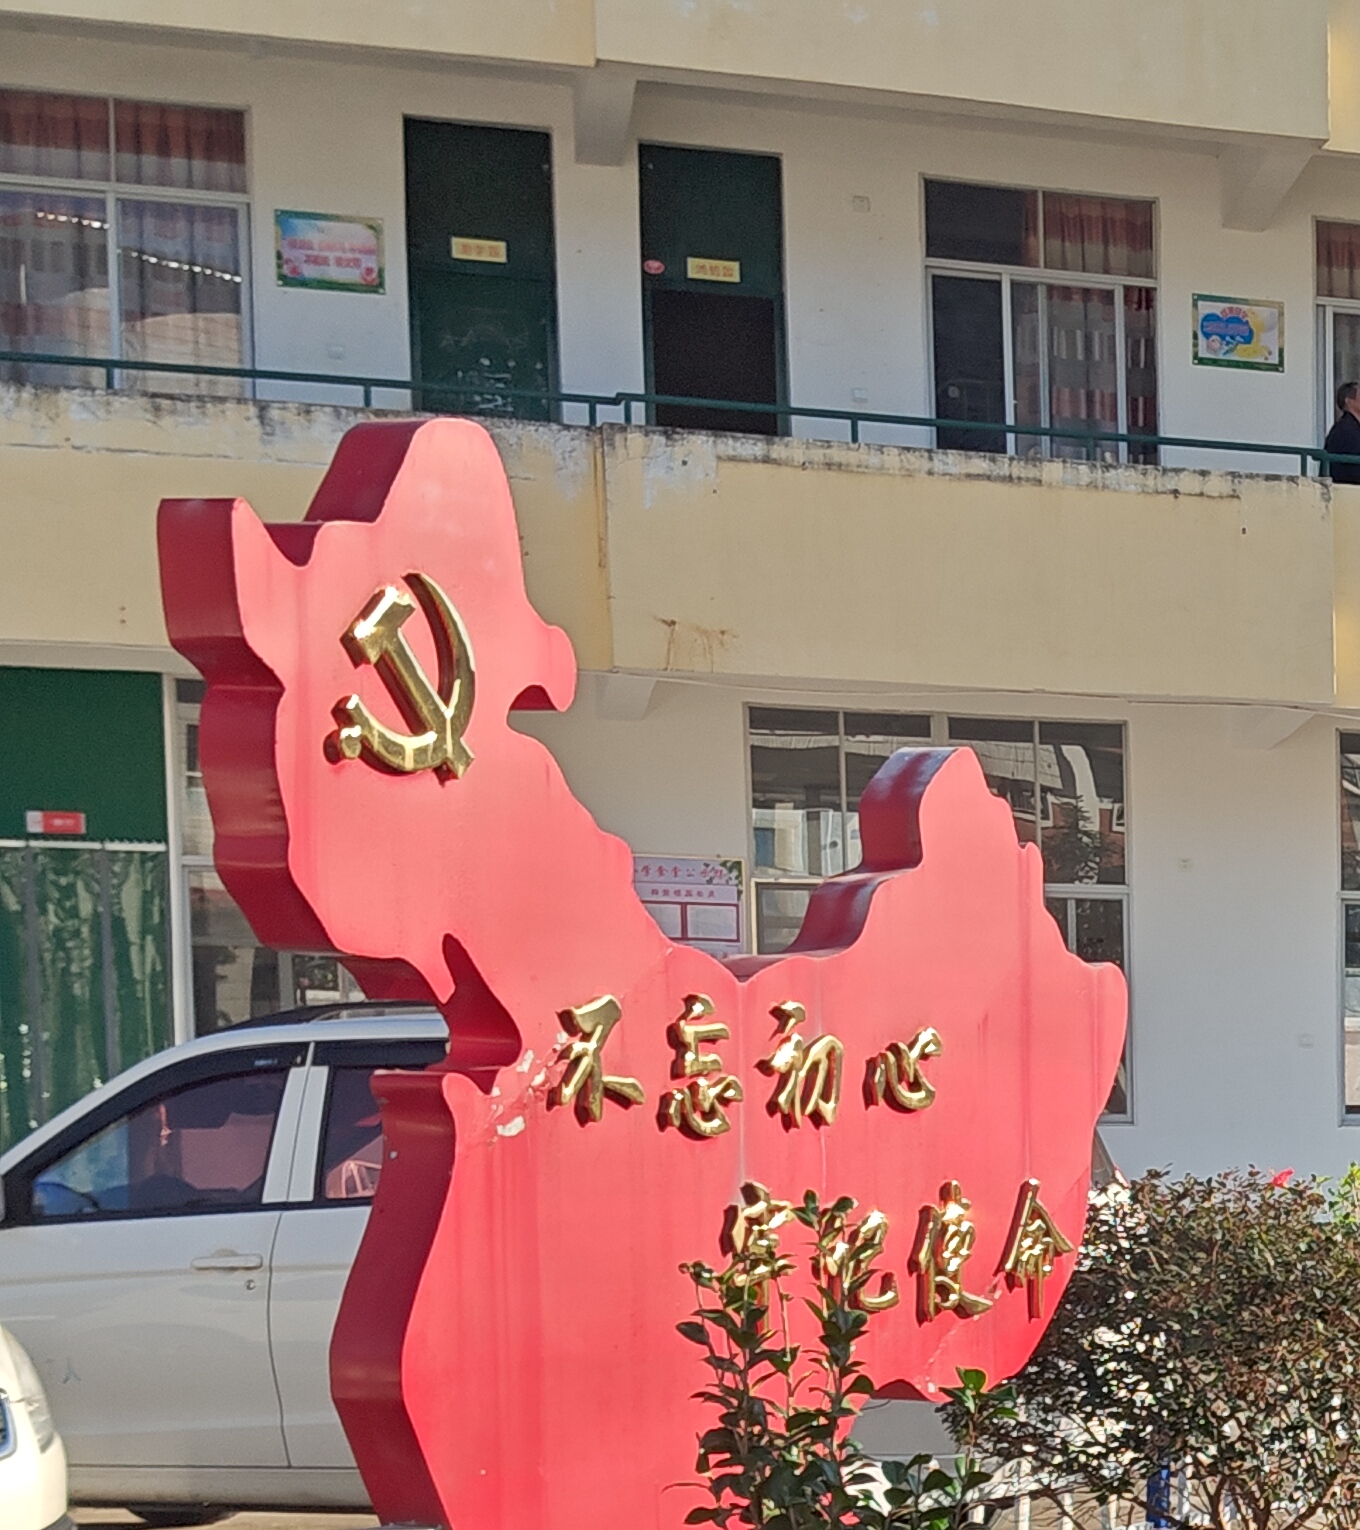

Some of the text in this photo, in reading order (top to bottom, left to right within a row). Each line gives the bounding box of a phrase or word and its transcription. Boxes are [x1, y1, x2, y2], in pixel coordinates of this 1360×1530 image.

[546, 993, 944, 1141] 不忘初心
[719, 1177, 1075, 1330] 牢记使命
